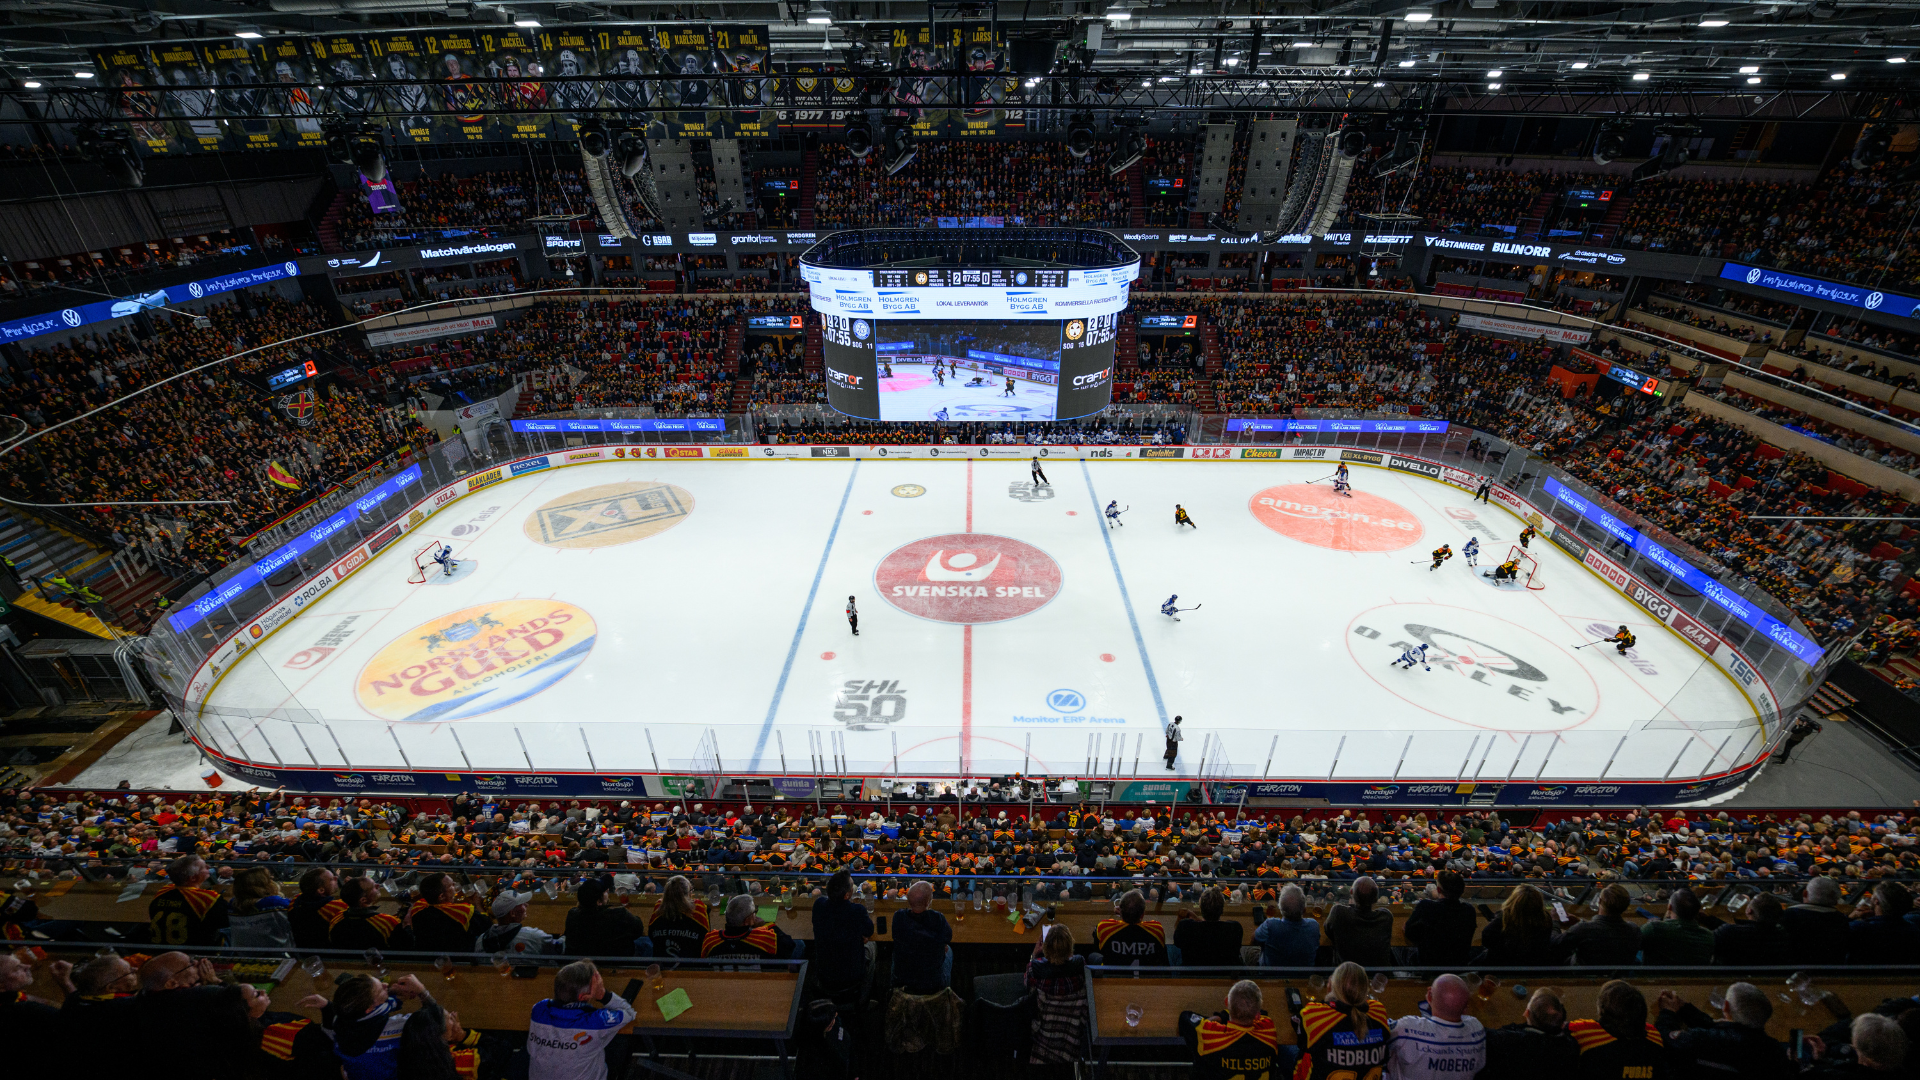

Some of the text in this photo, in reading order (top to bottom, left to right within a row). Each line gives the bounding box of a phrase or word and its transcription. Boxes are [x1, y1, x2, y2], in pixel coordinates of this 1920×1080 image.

[424, 36, 440, 54] 12
[481, 34, 496, 52] 12
[540, 33, 554, 51] 14
[559, 36, 585, 46] SALMING
[598, 32, 611, 50] 17
[617, 35, 643, 46] SALMING
[657, 31, 671, 50] 18
[716, 31, 730, 49] 21
[893, 29, 907, 47] 26
[204, 47, 214, 64] 6
[258, 44, 268, 62] 7
[311, 41, 327, 59] 10
[369, 39, 383, 57] 11
[97, 53, 108, 71] 1
[150, 49, 161, 67] 4
[795, 111, 823, 120] 1977
[420, 241, 517, 260] Matchvärdslogen
[546, 240, 581, 249] SPORTS
[1434, 238, 1486, 252] VÄSTANHEDE
[1491, 242, 1551, 258] BILINORR
[962, 274, 981, 283] 07:55
[835, 294, 872, 303] HOLMGREN
[839, 301, 869, 310] BYGG AB
[954, 299, 989, 307] LEVERANTÖR
[1054, 299, 1093, 307] KOMMERSIELLA
[472, 318, 494, 329] MAXI
[827, 329, 851, 347] 07:55
[1086, 328, 1110, 346] 07:55
[1561, 331, 1588, 342] MAXI
[1031, 373, 1051, 383] BYGG
[1090, 447, 1113, 459] nds
[1244, 449, 1278, 459] Cheers
[1294, 448, 1326, 457] IMPACT BY
[1352, 453, 1382, 463] XL-BYGG
[1391, 458, 1439, 476] DIVELLO
[467, 469, 502, 487] BLÅKLÄDER
[435, 488, 456, 506] JULA
[468, 505, 502, 528] Telia
[1258, 494, 1415, 533] amazon.se
[261, 549, 299, 576] AB KARL HEDIN
[345, 552, 365, 570] GIDA
[1649, 552, 1686, 578] AB KARL HEDIN
[1585, 553, 1627, 587] CRAMO
[302, 576, 333, 601] ROLBA
[892, 585, 1045, 598] SVENSKA SPEL
[201, 605, 211, 616] AB
[225, 585, 243, 600] HEDIN
[1633, 587, 1669, 619] BYGG
[1705, 587, 1750, 619] AB KARL HEDIN
[260, 605, 286, 626] Höganäs
[263, 608, 292, 631] Borgestad
[314, 614, 361, 646] SVENSKA
[1682, 624, 1711, 646] KÅAB
[328, 629, 356, 648] SPEL
[370, 609, 574, 697] NORRLANDS
[408, 627, 566, 698] GULD
[1730, 652, 1756, 686] TSG
[452, 652, 550, 697] ALKOHOLFRI
[843, 679, 908, 694] SHL
[833, 694, 907, 726] 50
[1013, 715, 1126, 725] Monitor ERP Arena
[333, 776, 365, 786] Nordsjö
[371, 774, 415, 784] FÄRGTON
[475, 778, 507, 787] Nordsjö
[514, 775, 558, 785] FÄRGTON
[601, 780, 634, 788] Nordsjö
[781, 779, 810, 788] sunda
[1142, 783, 1171, 791] sunda
[1256, 784, 1302, 793] FÄRGTON
[1364, 789, 1396, 797] Nordsjö
[1407, 784, 1453, 794] FÄRGTON
[1530, 789, 1563, 797] Nordsjö
[1574, 785, 1621, 794] FÄRGTON
[668, 928, 699, 940] FOTHÄLSA
[1111, 940, 1156, 956] OMPA
[1410, 1028, 1436, 1038] TEGERA
[1415, 1042, 1454, 1055] Leksands
[1221, 1056, 1272, 1071] NILSSON
[1428, 1057, 1476, 1072] MOBERG
